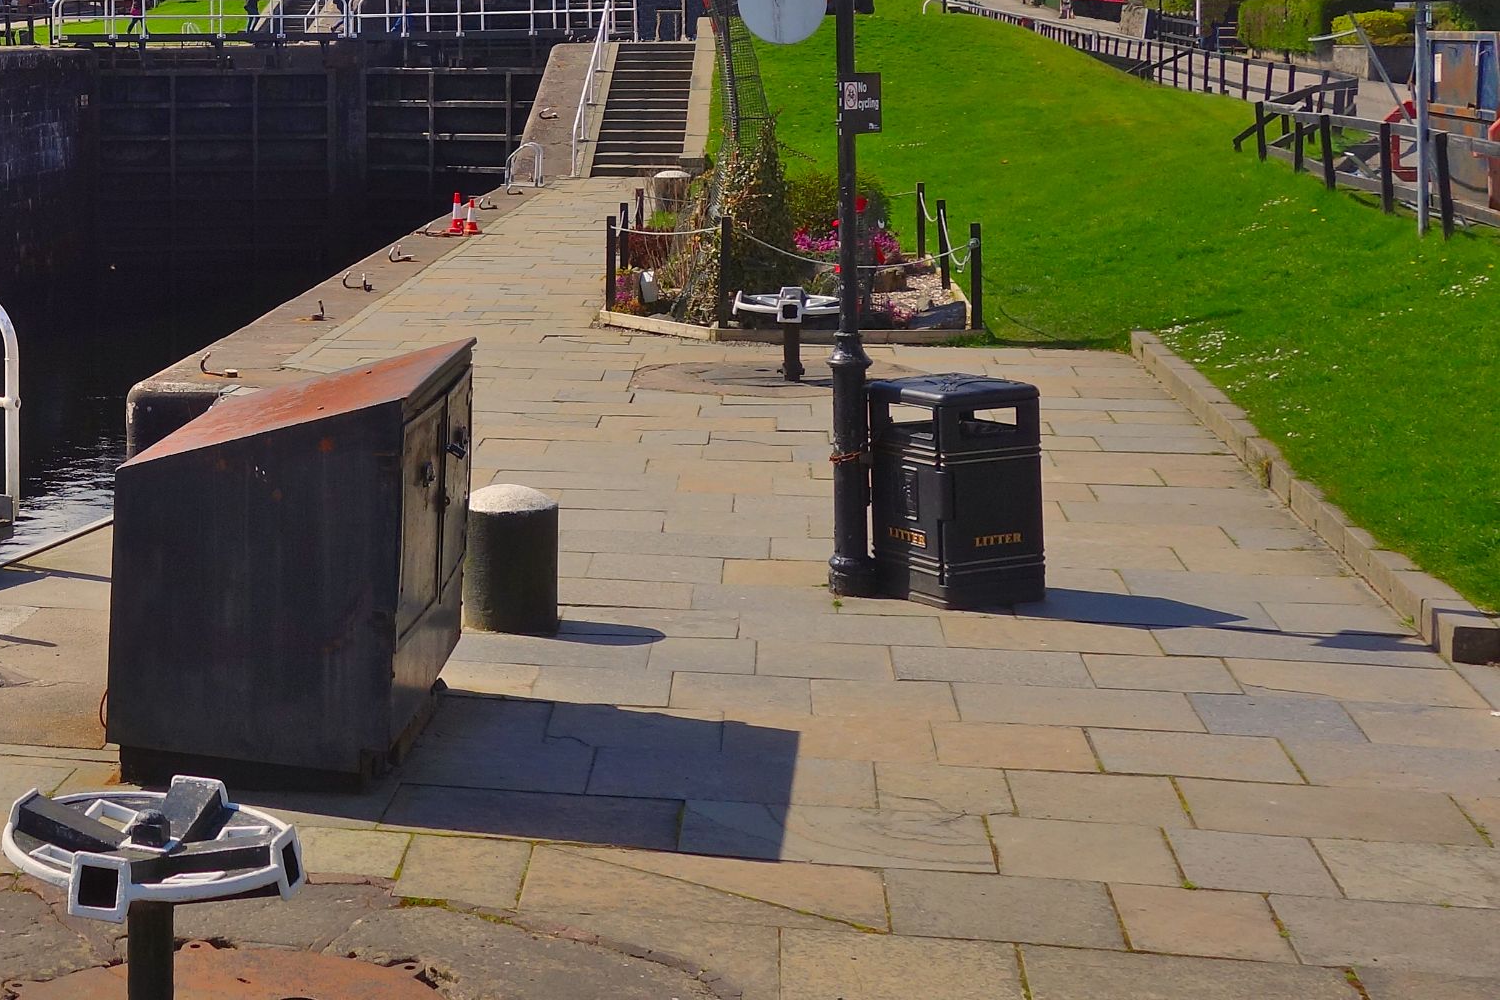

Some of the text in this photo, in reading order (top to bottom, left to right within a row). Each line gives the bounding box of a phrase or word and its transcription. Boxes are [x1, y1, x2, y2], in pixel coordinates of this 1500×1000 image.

[858, 82, 867, 92] No
[858, 98, 879, 111] cycling
[888, 527, 926, 545] LITTER
[974, 532, 1022, 547] LITTER
